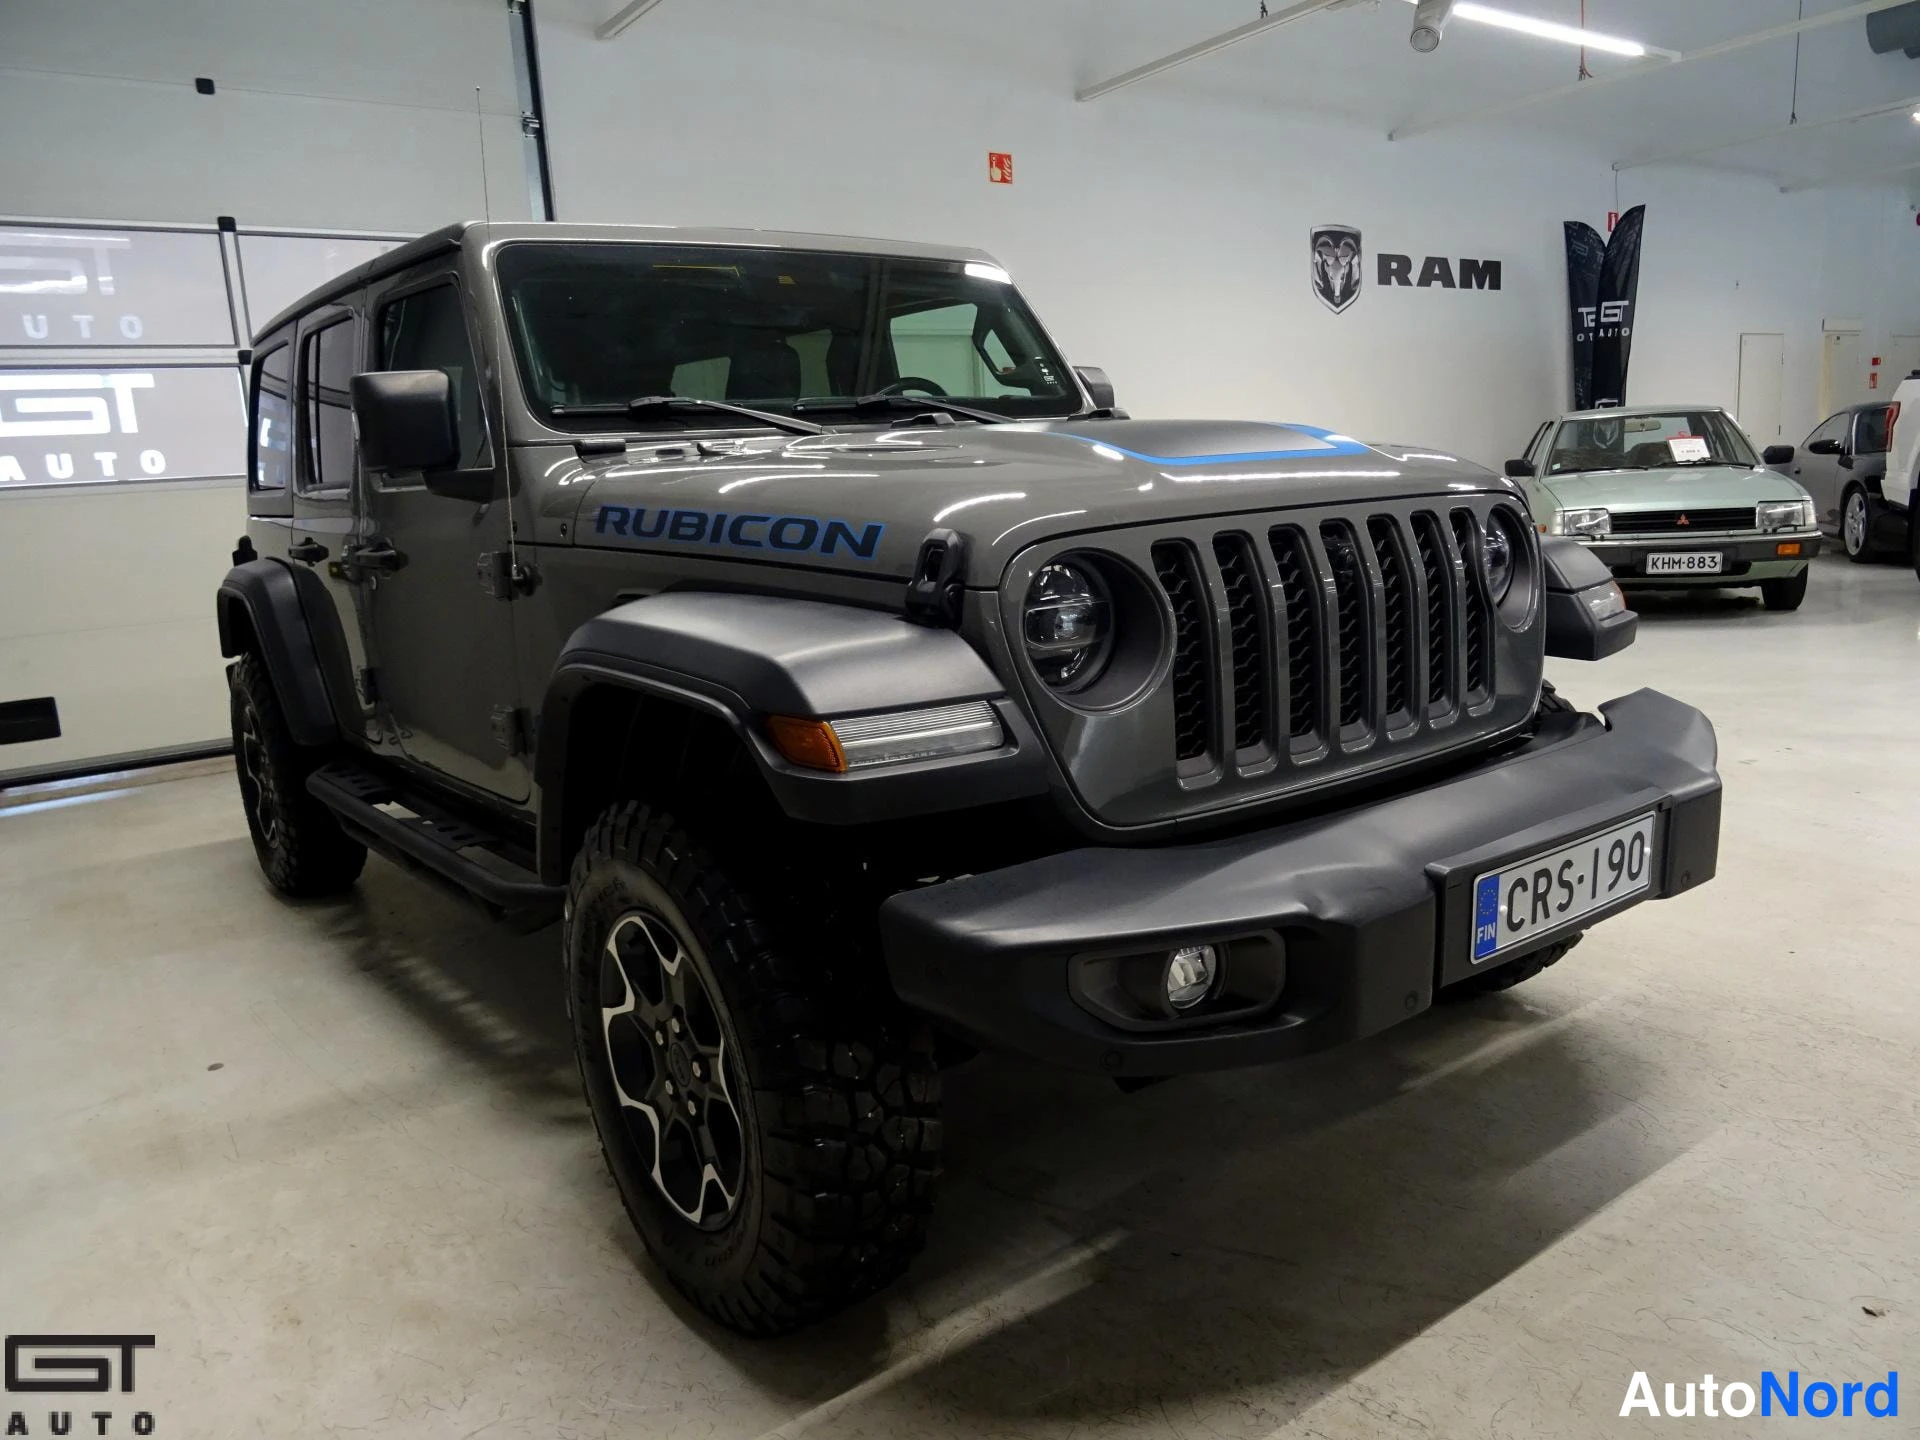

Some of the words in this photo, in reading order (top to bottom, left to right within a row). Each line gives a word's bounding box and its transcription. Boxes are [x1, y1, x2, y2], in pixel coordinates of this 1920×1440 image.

[1377, 253, 1501, 290] RAM
[22, 315, 144, 340] UTO
[0, 449, 167, 482] AUTO
[595, 505, 885, 560] RUBICON
[1650, 555, 1718, 571] KHM-883
[1506, 830, 1645, 932] CRS-190
[1476, 921, 1497, 945] FIN
